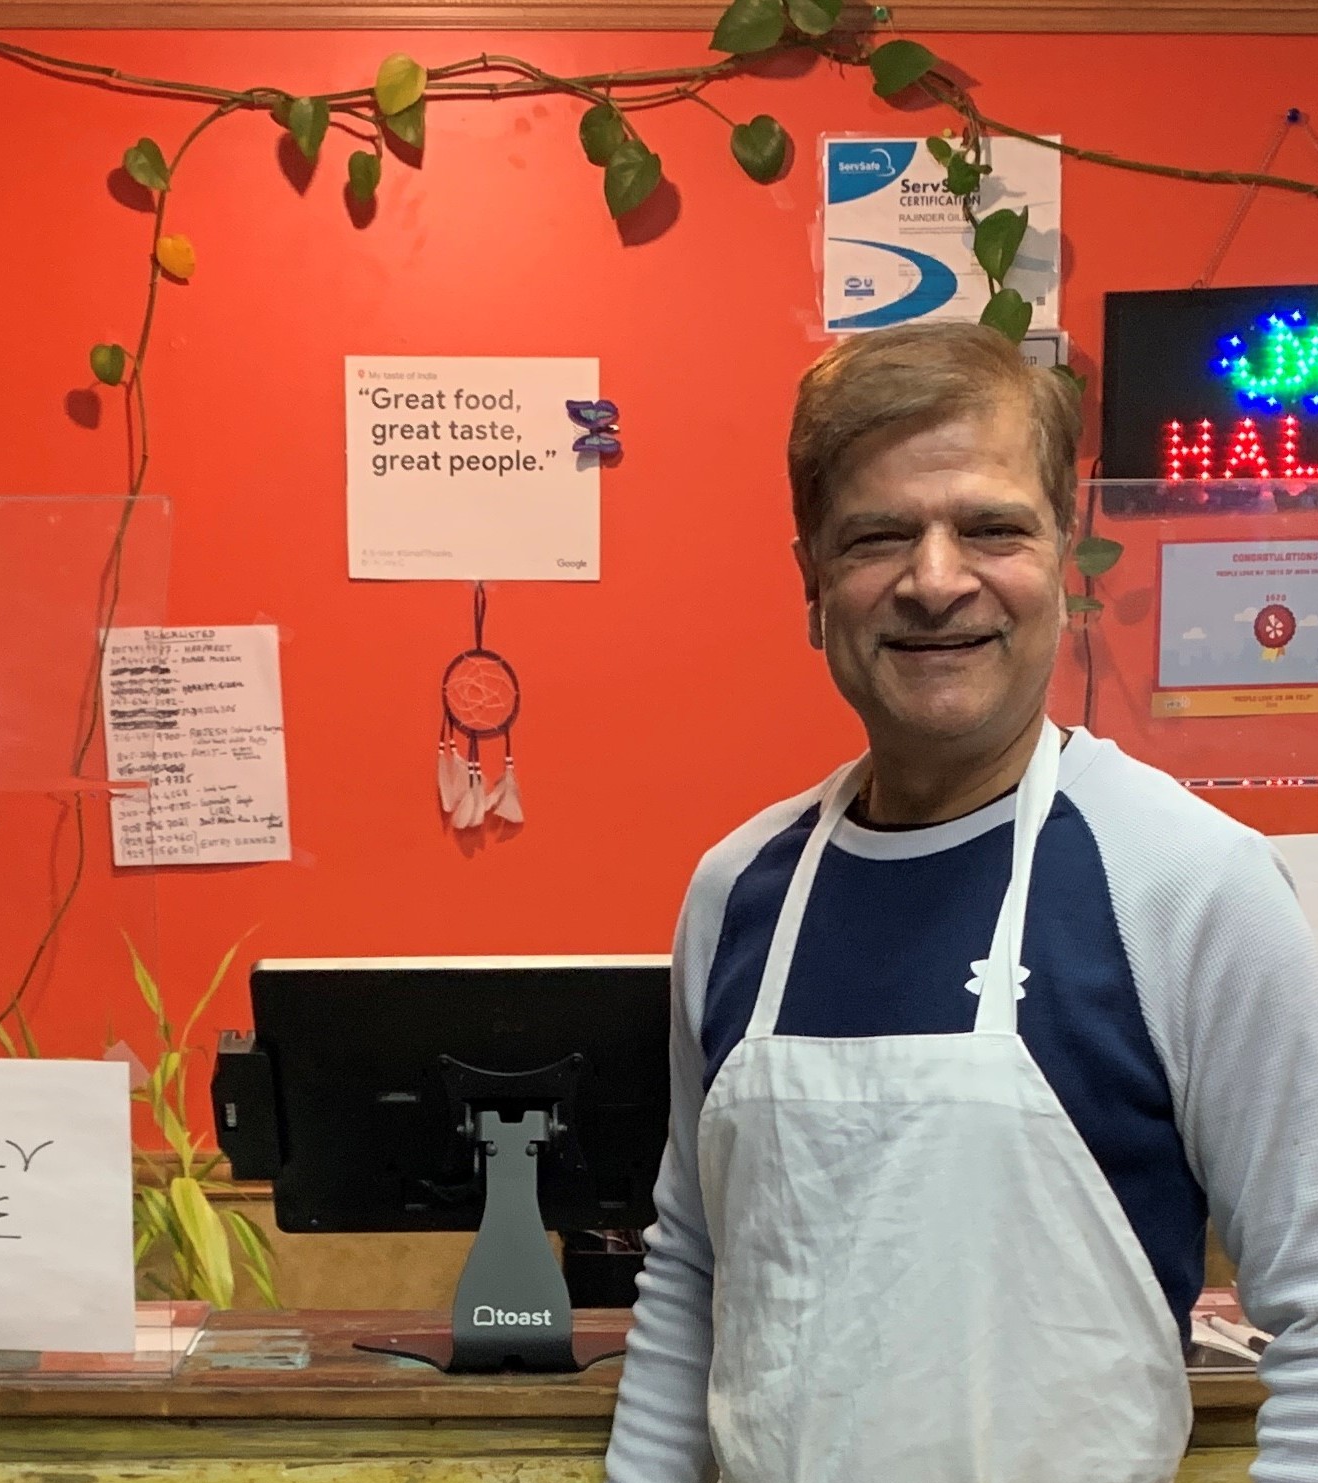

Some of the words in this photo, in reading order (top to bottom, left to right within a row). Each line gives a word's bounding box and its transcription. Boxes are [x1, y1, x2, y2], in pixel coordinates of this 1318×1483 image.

[899, 213, 945, 222] RAJINDER
[406, 371, 415, 380] of
[453, 388, 522, 413] food,
[371, 420, 441, 446] great
[448, 420, 523, 444] taste,
[372, 451, 442, 477] great
[556, 558, 588, 570] Google
[496, 1308, 552, 1327] toast
